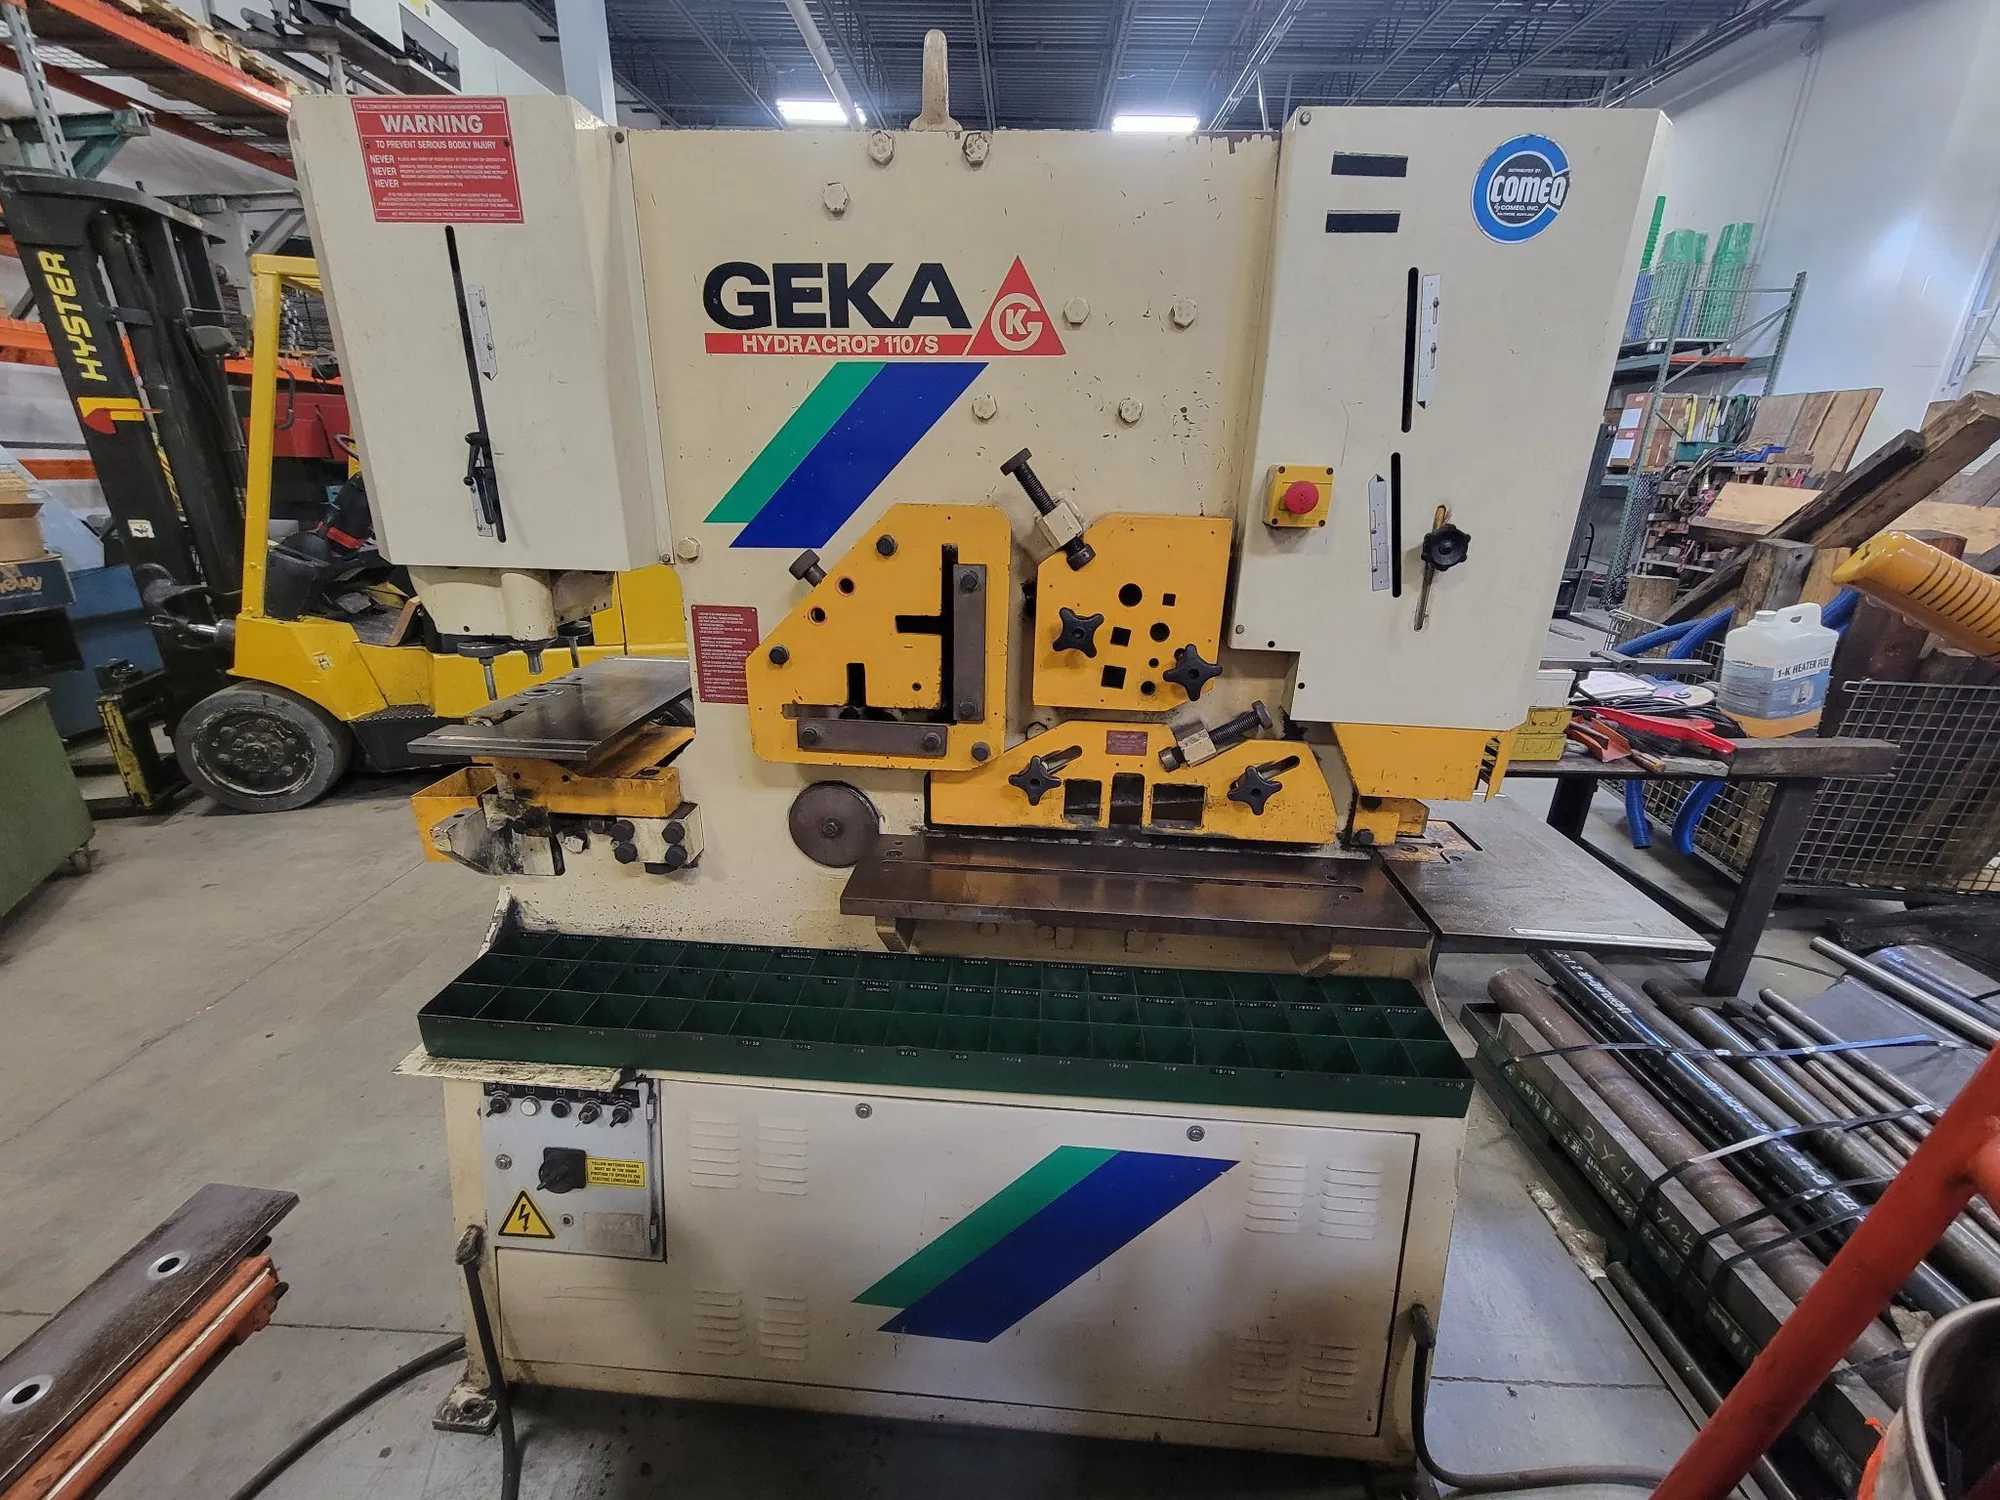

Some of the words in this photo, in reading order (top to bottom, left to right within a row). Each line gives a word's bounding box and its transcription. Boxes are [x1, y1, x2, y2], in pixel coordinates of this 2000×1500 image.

[380, 114, 483, 134] WARNING
[376, 140, 385, 149] TO
[386, 140, 416, 149] PREVENT
[417, 140, 447, 149] SERIOUS
[448, 140, 472, 149] BODILY
[472, 140, 496, 149] INJURY
[370, 154, 395, 164] NEVER
[372, 166, 398, 176] NEVER
[375, 179, 400, 188] NEVER
[702, 261, 972, 330] GEKA
[37, 250, 108, 382] HYSTER
[742, 335, 880, 354] HYDRACROP
[884, 335, 939, 354] 110/S
[1793, 660, 1816, 674] HEATER
